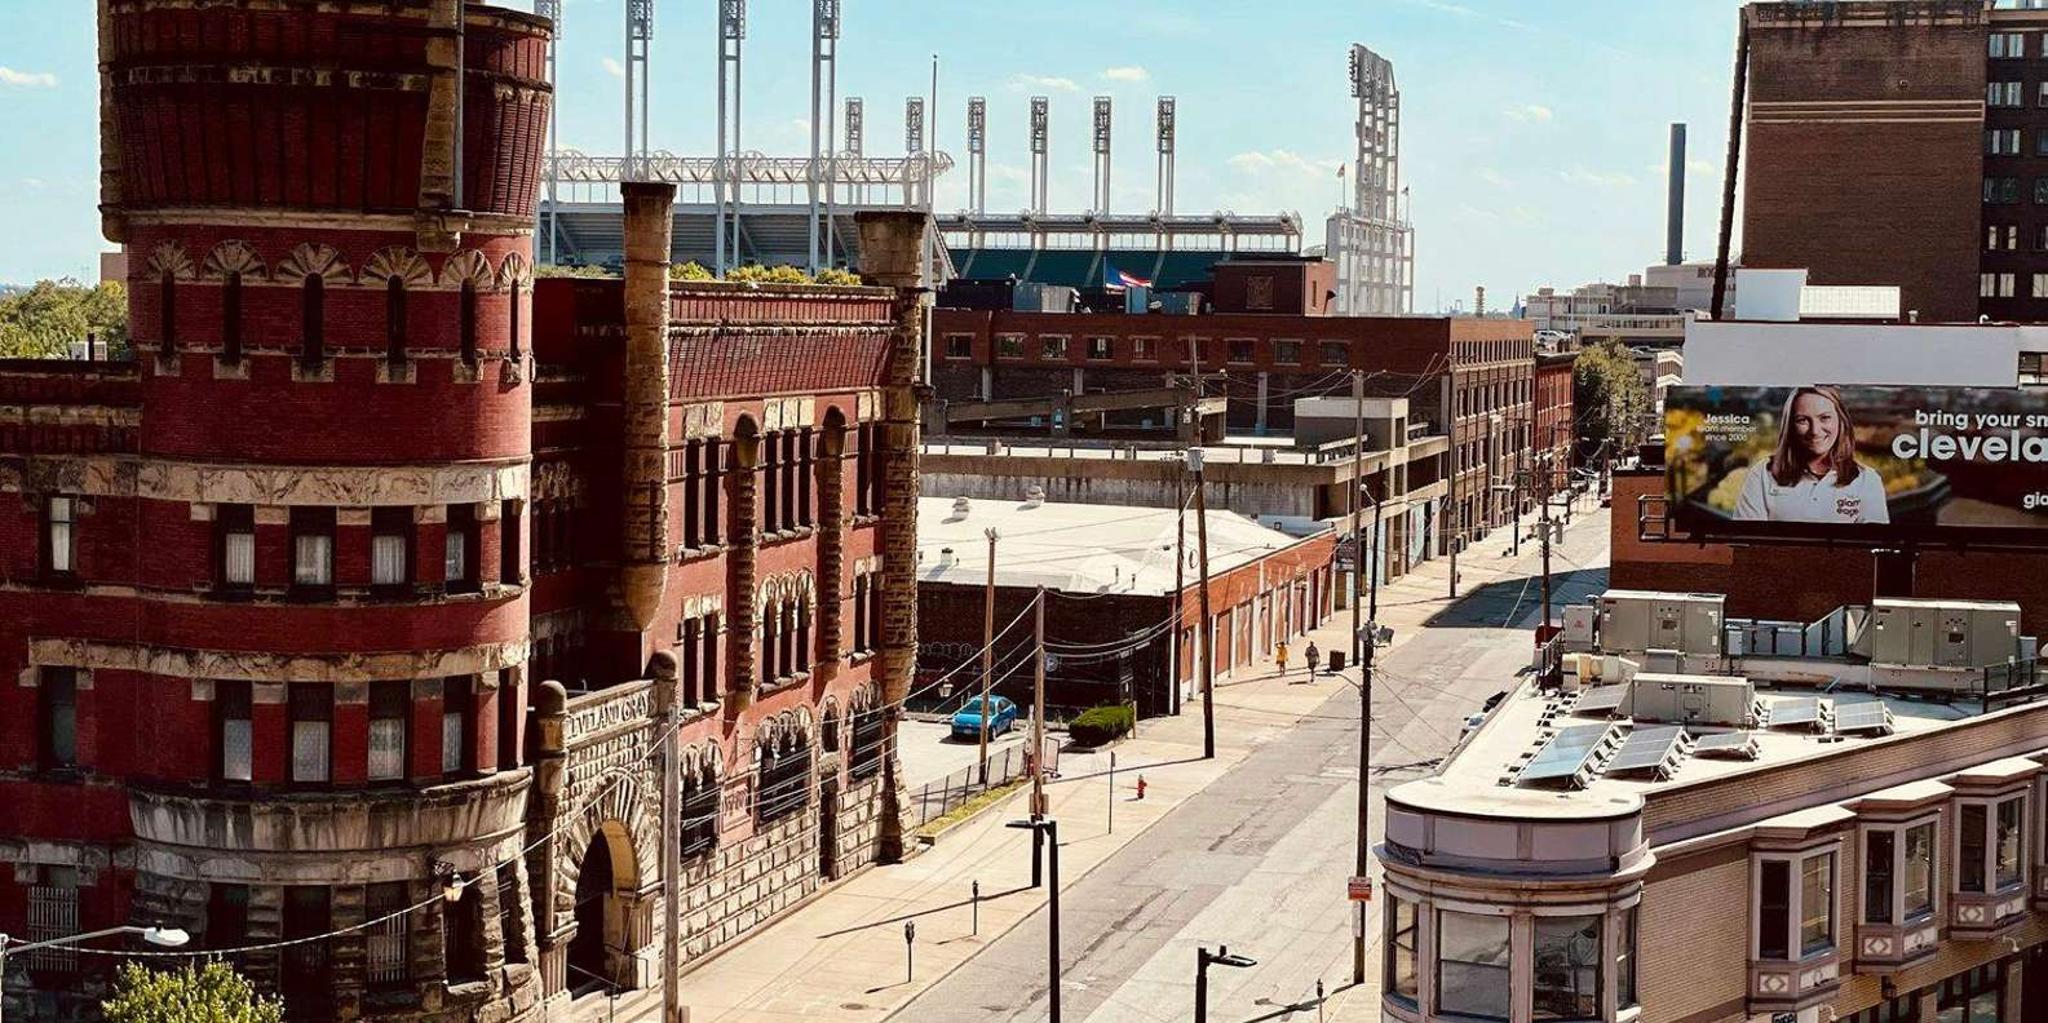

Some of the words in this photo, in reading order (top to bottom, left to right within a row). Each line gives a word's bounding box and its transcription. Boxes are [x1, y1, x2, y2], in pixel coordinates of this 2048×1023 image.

[1704, 413, 1750, 424] Jessica
[1915, 409, 1968, 430] bring
[1975, 413, 2020, 430] your
[1892, 427, 2048, 462] clevela
